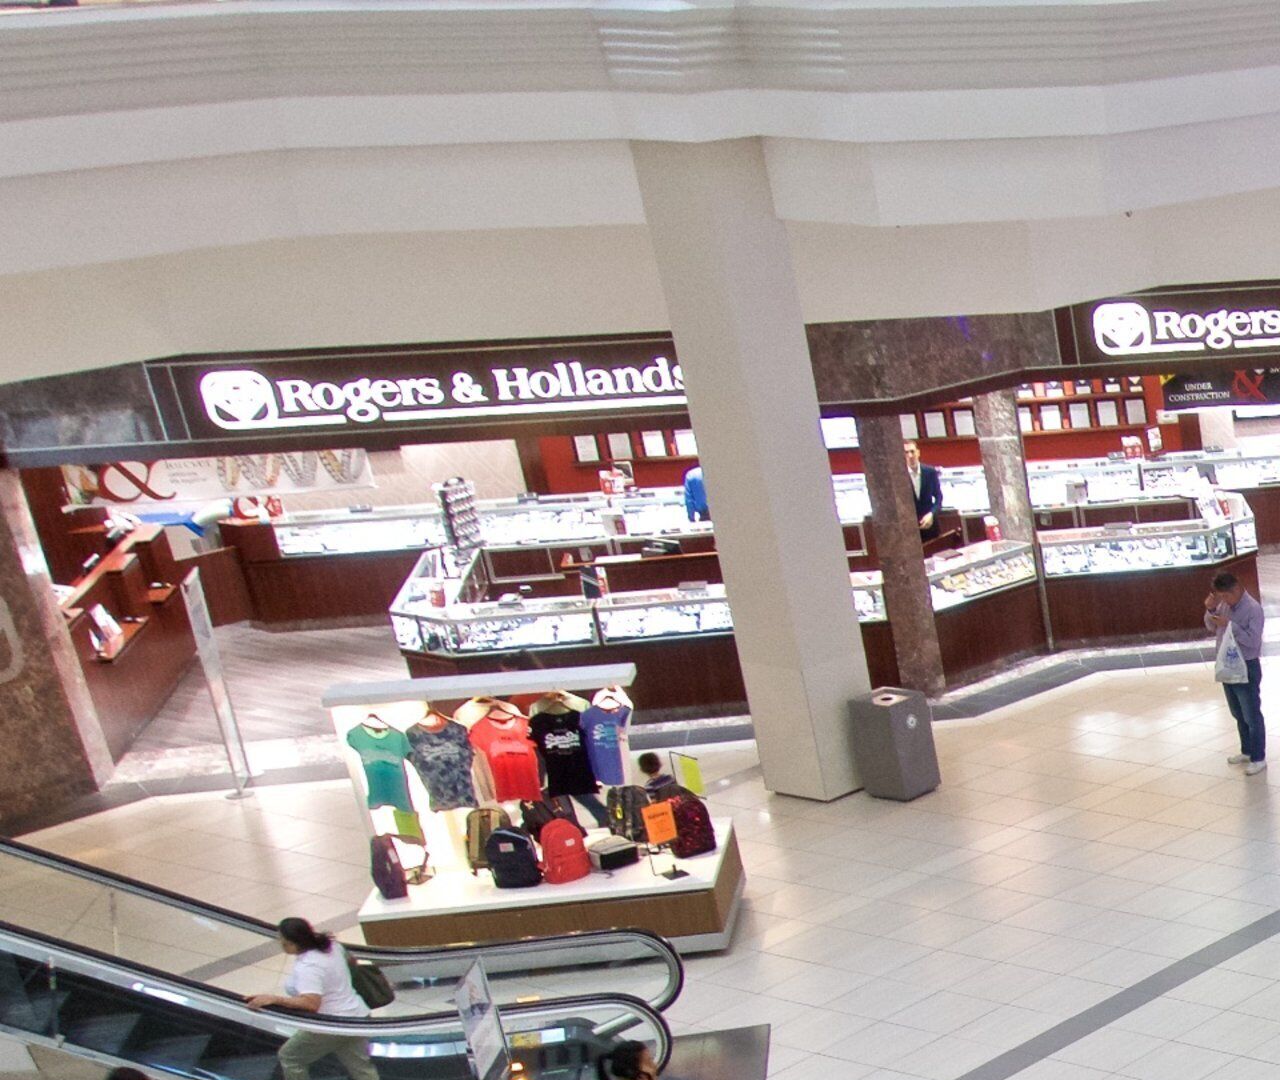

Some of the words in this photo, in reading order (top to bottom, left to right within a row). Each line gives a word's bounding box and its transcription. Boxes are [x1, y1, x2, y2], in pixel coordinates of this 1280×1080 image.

[276, 374, 446, 423] Rogers
[451, 374, 489, 403] &
[491, 357, 687, 401] Hollands
[1184, 382, 1213, 392] UNDER
[1168, 391, 1231, 403] CONSTRUCTION
